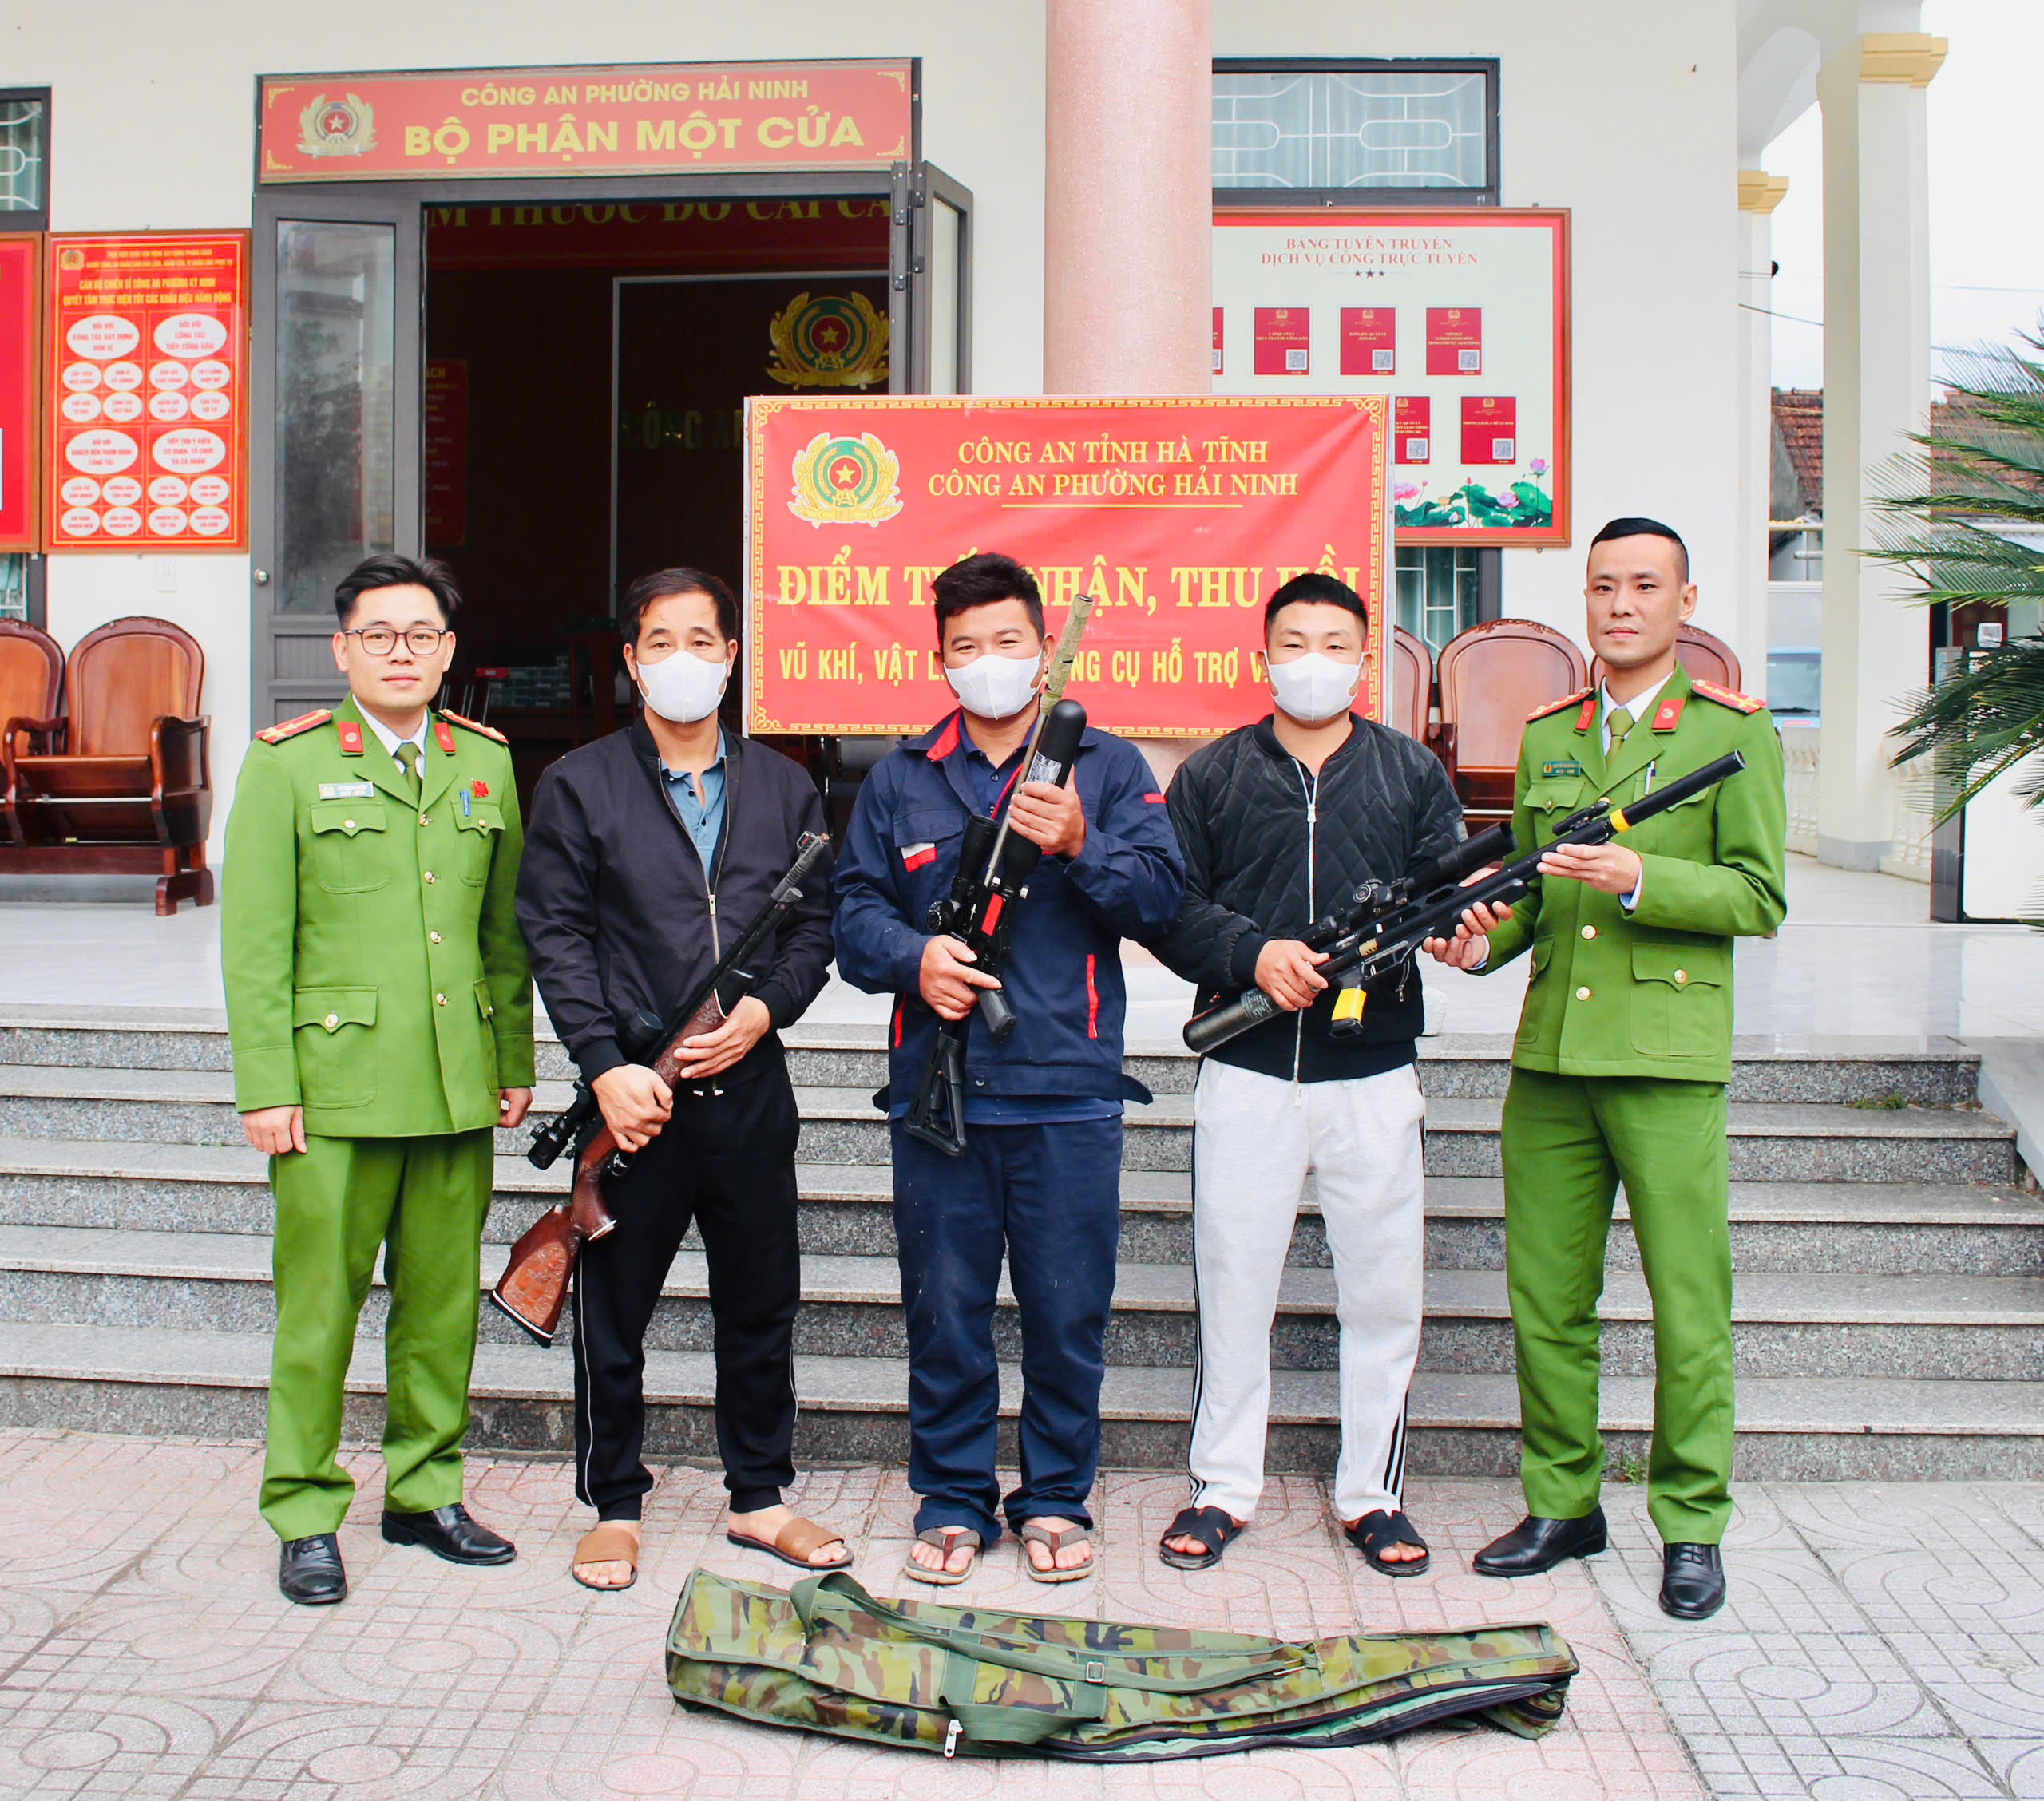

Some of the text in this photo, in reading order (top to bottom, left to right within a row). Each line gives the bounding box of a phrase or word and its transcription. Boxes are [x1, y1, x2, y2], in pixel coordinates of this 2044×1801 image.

[461, 74, 809, 107] CÔNG AN PHƯỜNG HẢI NINH
[405, 105, 866, 164] BỘ PHẬN MỘT CỬA
[957, 432, 1269, 465] CÔNG AN TỈNH HÀ TĨNH
[928, 465, 1298, 497] CÔNG AN PHƯỜNG HẢI NINH
[776, 544, 891, 606] ĐIỂM
[1171, 567, 1264, 608] THU
[778, 641, 807, 680] VŨ
[818, 641, 863, 685] KHÍ,
[873, 642, 918, 687] VẬT
[1111, 650, 1140, 688] CỤ
[1152, 637, 1182, 683] HỖ
[1194, 647, 1239, 689] TRỢ
